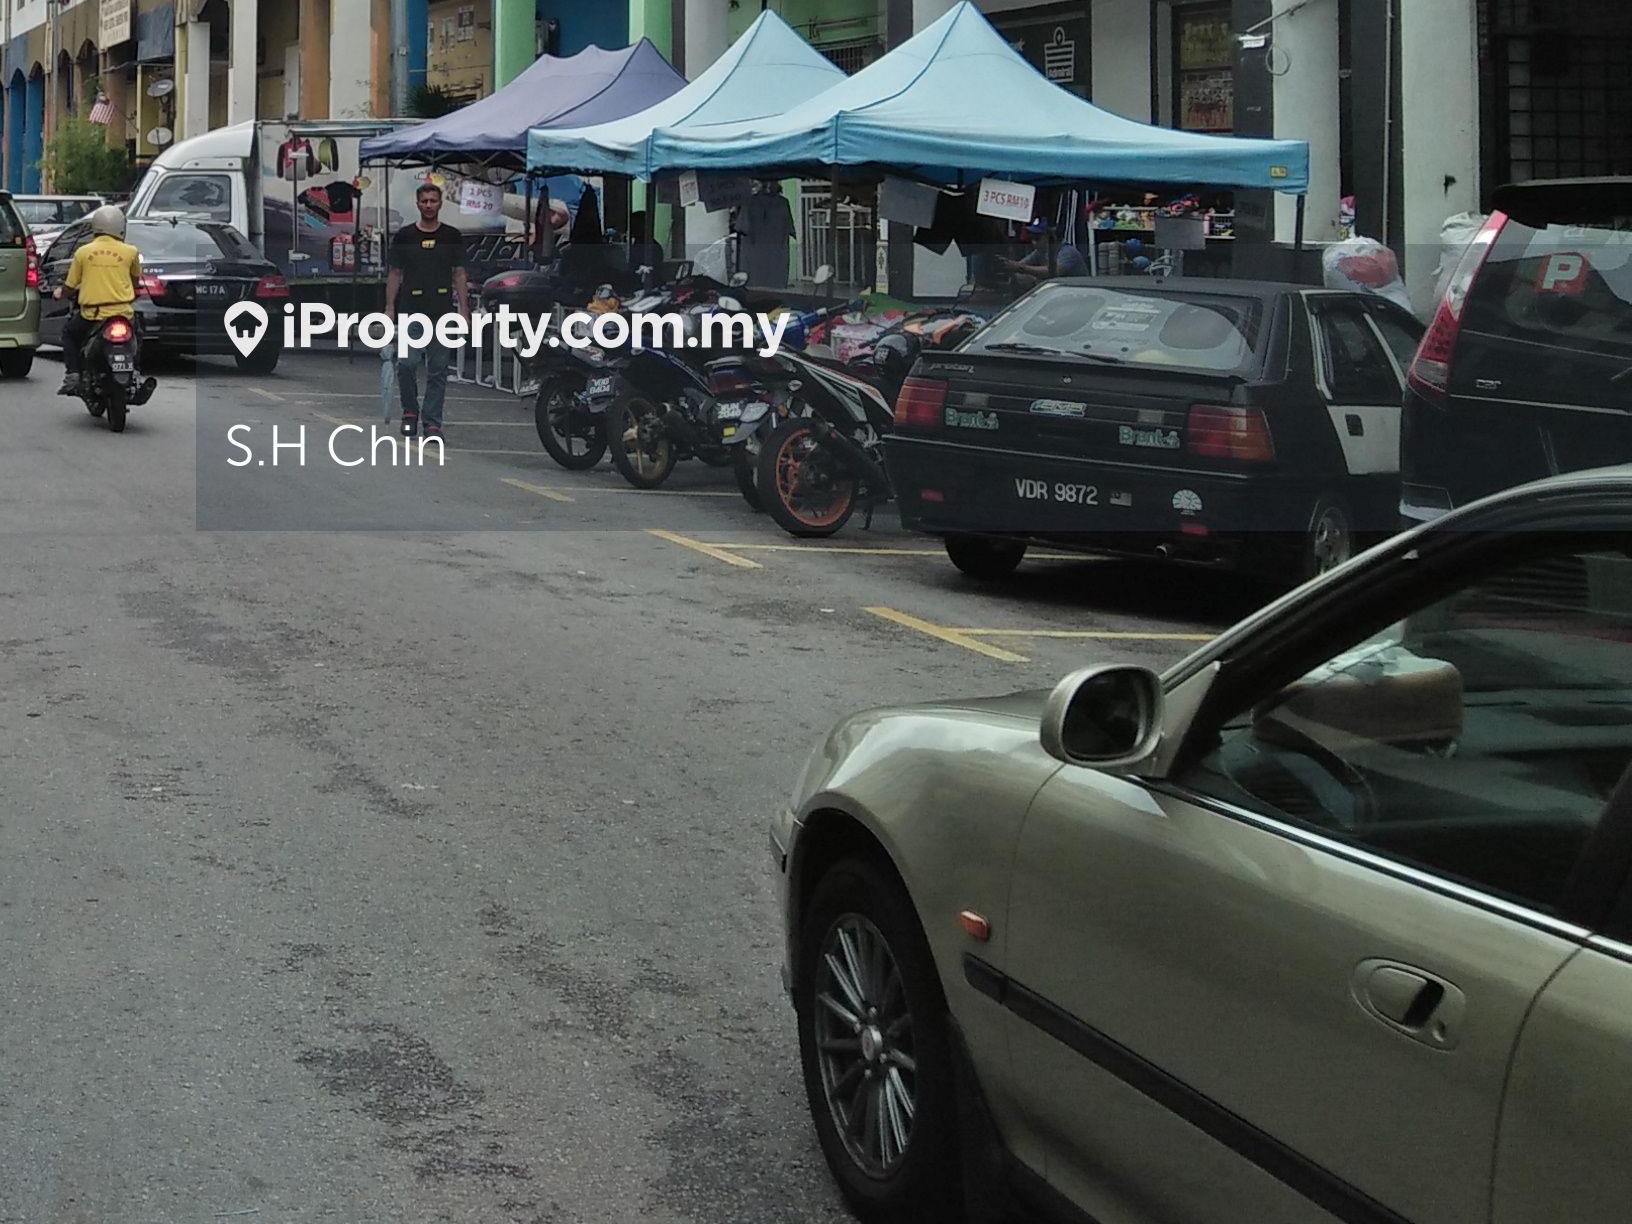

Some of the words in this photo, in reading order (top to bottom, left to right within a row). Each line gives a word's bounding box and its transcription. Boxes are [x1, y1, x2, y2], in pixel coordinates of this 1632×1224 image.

[983, 190, 989, 202] 3
[991, 191, 1006, 205] PCS
[1542, 255, 1583, 289] P
[1015, 478, 1049, 500] VDR
[1054, 483, 1099, 505] 9872
